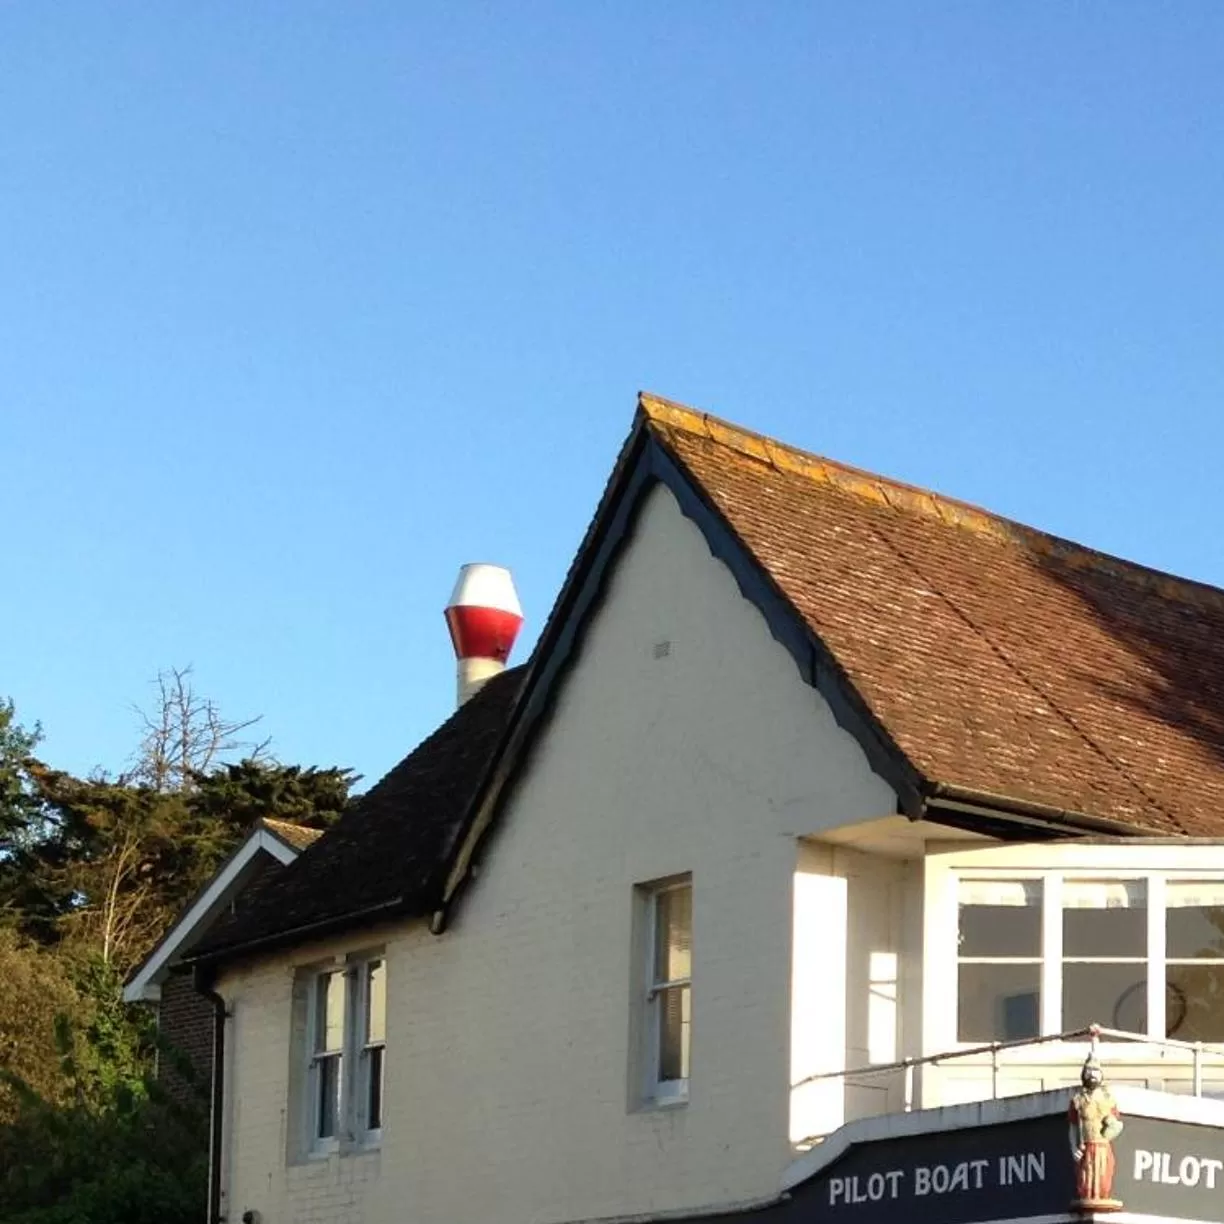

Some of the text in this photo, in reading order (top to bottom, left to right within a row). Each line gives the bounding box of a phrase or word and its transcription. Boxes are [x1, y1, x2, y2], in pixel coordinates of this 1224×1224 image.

[829, 1152, 1046, 1206] PILOT BOAT INN
[1133, 1150, 1223, 1190] PILOT
